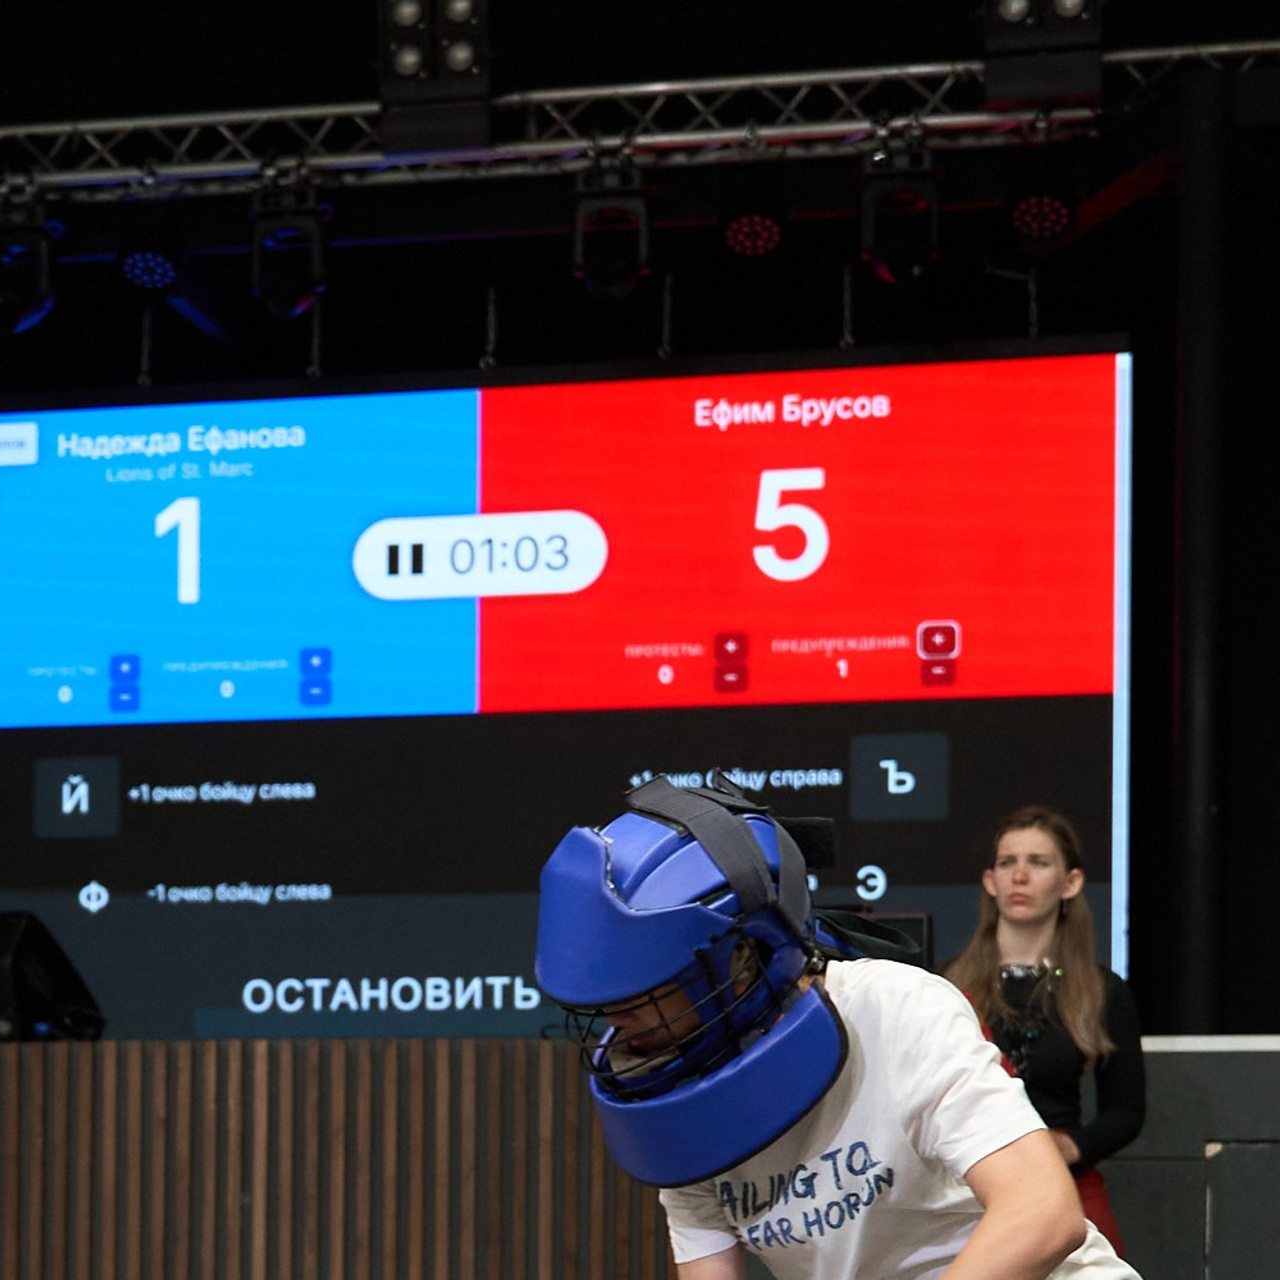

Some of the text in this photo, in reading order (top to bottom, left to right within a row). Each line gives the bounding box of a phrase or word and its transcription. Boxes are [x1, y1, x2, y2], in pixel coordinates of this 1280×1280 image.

[694, 394, 891, 431] Ефим Брусов
[57, 424, 306, 460] Надежда Ефанова
[105, 466, 154, 483] Lions
[157, 463, 177, 482] of
[209, 460, 253, 478] Marc
[752, 467, 830, 582] 5
[155, 496, 201, 604] 1
[449, 533, 570, 576] 01:03
[657, 664, 674, 685] 0
[836, 658, 848, 678] 1
[56, 684, 74, 704] 0
[219, 679, 236, 698] 0
[62, 775, 89, 814] Й
[151, 785, 198, 804] очко
[199, 781, 257, 804] бойцу
[259, 782, 317, 801] слева
[769, 768, 843, 792] справа
[879, 759, 915, 795] Ъ
[78, 881, 110, 914] Ф
[167, 885, 214, 904] очко
[215, 882, 273, 905] бойцу
[275, 883, 333, 902] слева
[855, 864, 888, 901] Э
[242, 976, 541, 1014] ОСТАНОВИТЬ
[719, 1163, 818, 1222] AILING
